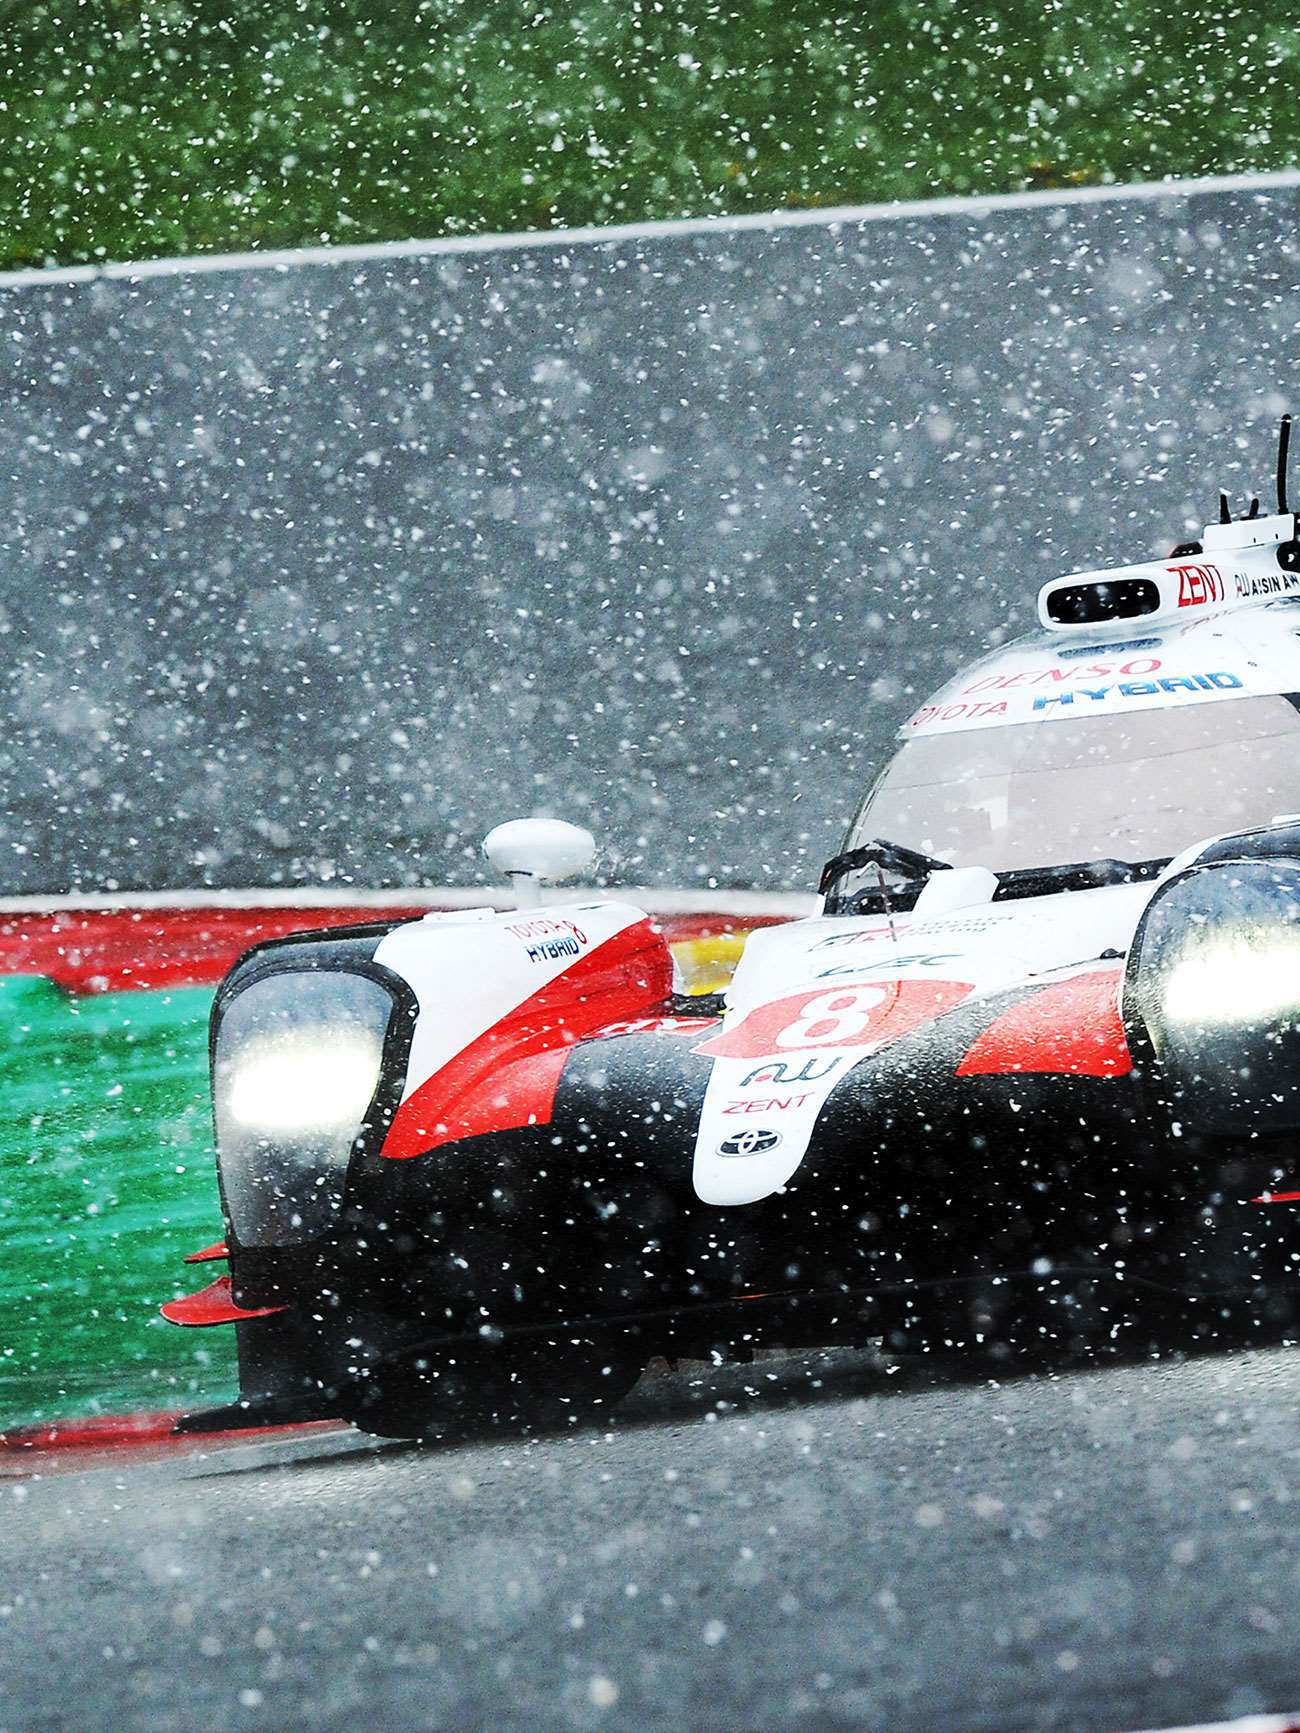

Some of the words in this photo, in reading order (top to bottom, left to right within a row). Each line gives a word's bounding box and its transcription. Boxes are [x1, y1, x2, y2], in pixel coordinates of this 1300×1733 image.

[1251, 578, 1281, 596] AISIN
[963, 659, 1162, 695] DENSO
[1032, 671, 1244, 711] HYBRID
[524, 936, 580, 963] HYBRID
[775, 987, 885, 1047] 8
[723, 1092, 816, 1115] ZENT
